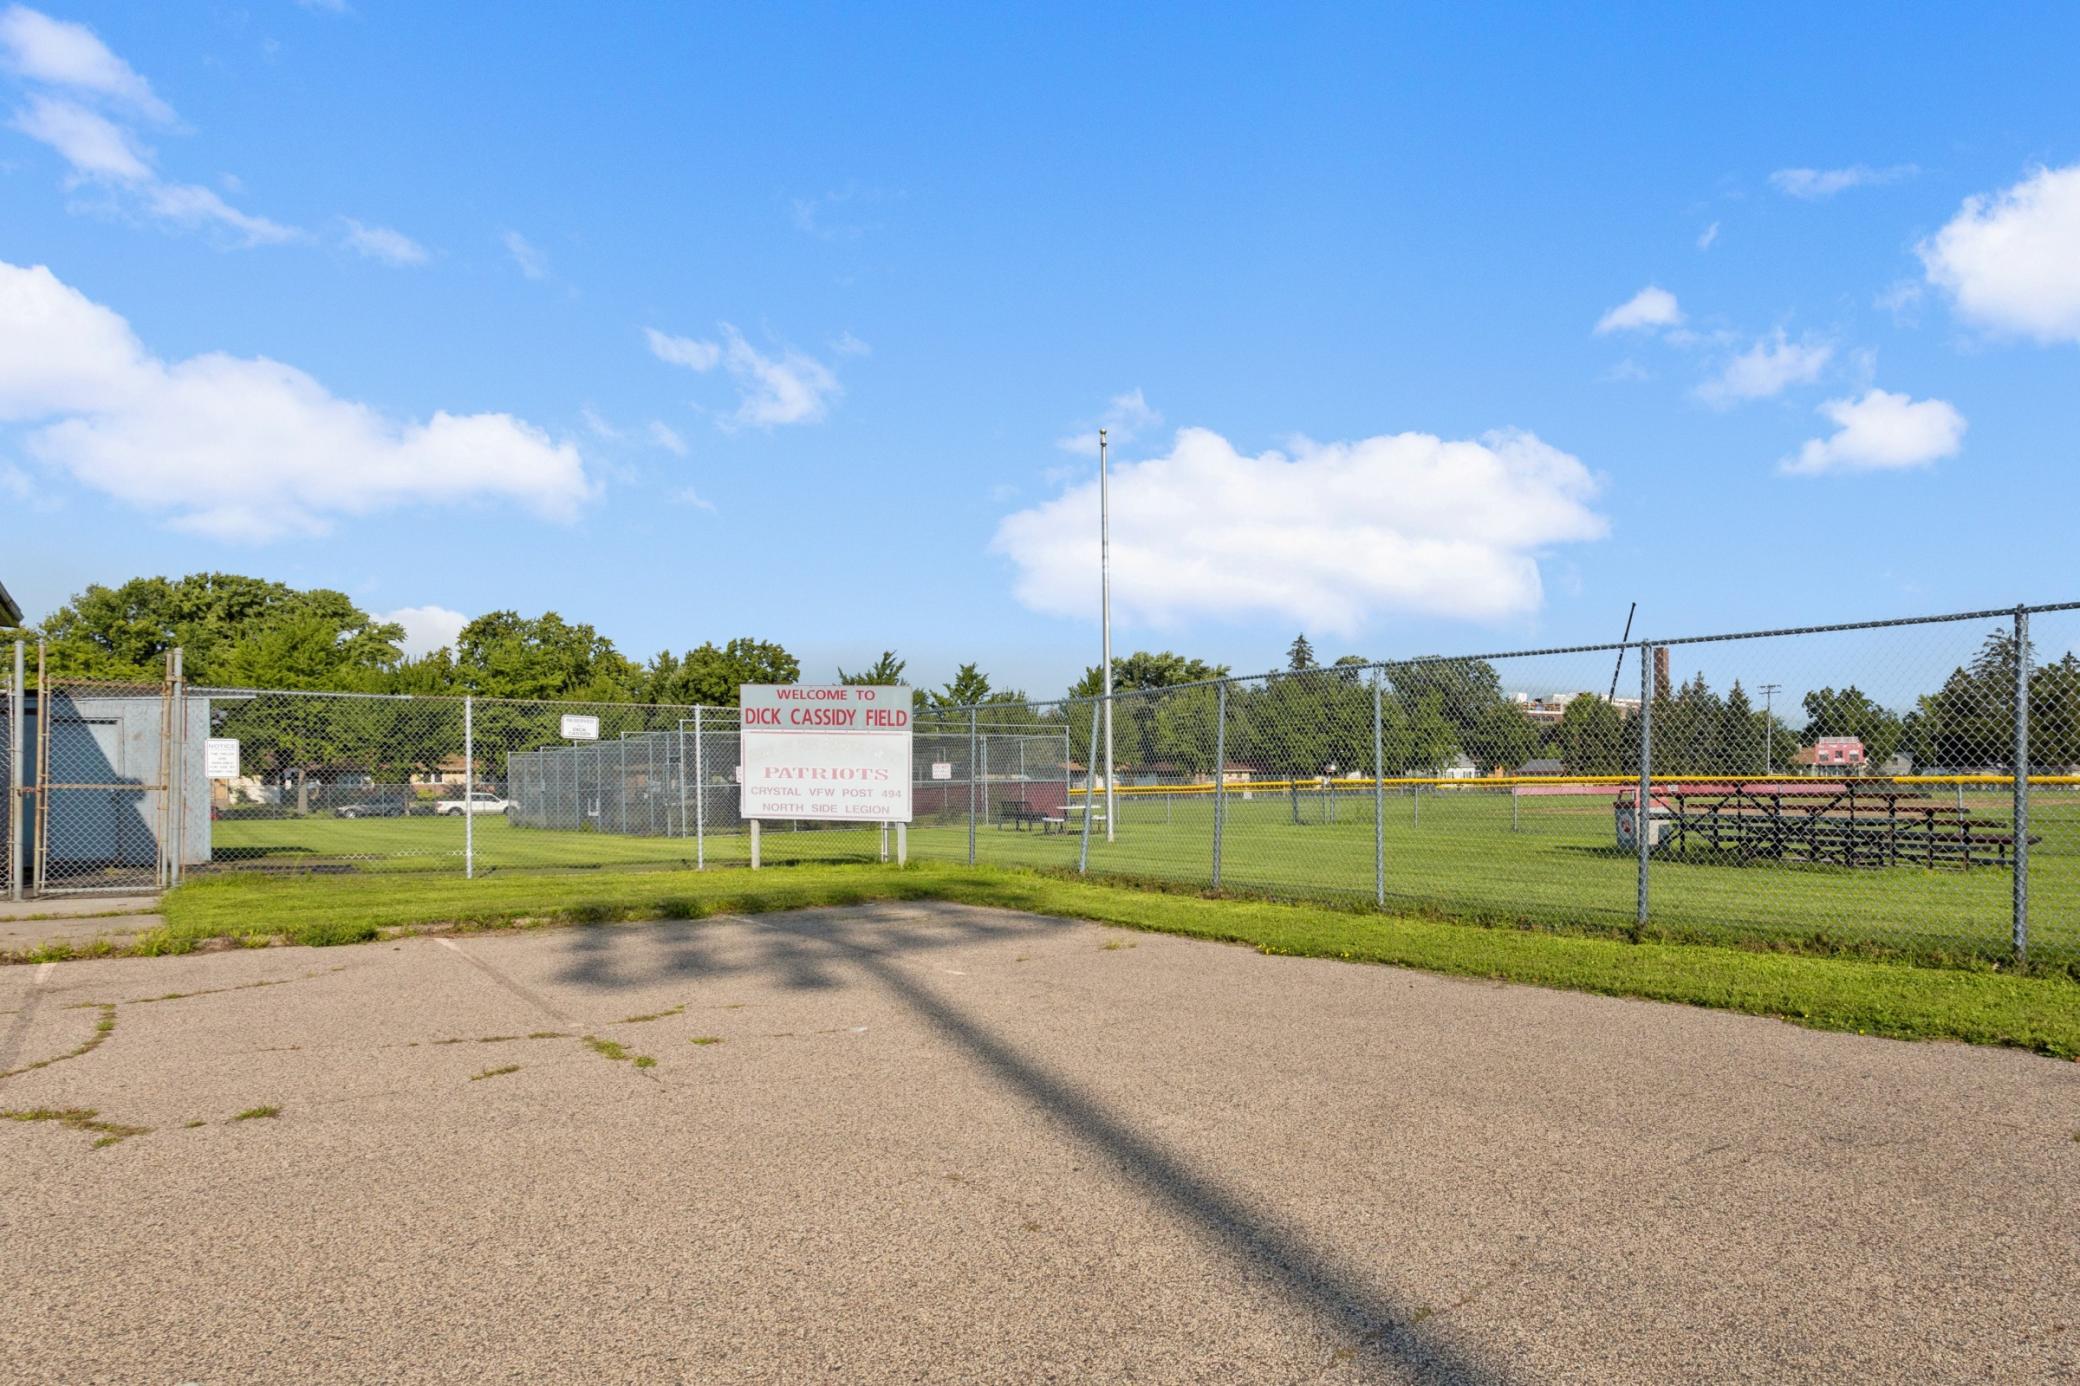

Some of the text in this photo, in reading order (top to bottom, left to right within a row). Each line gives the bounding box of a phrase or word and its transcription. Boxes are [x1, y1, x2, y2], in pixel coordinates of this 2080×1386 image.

[777, 689, 876, 701] WELCOME TO
[745, 708, 908, 727] DICK CASSIDY FIELD
[764, 767, 889, 781] PATRIOTS
[751, 786, 902, 799] CRYSTAL VFW POST 494
[762, 803, 890, 814] NORTH SIDE LEGION
